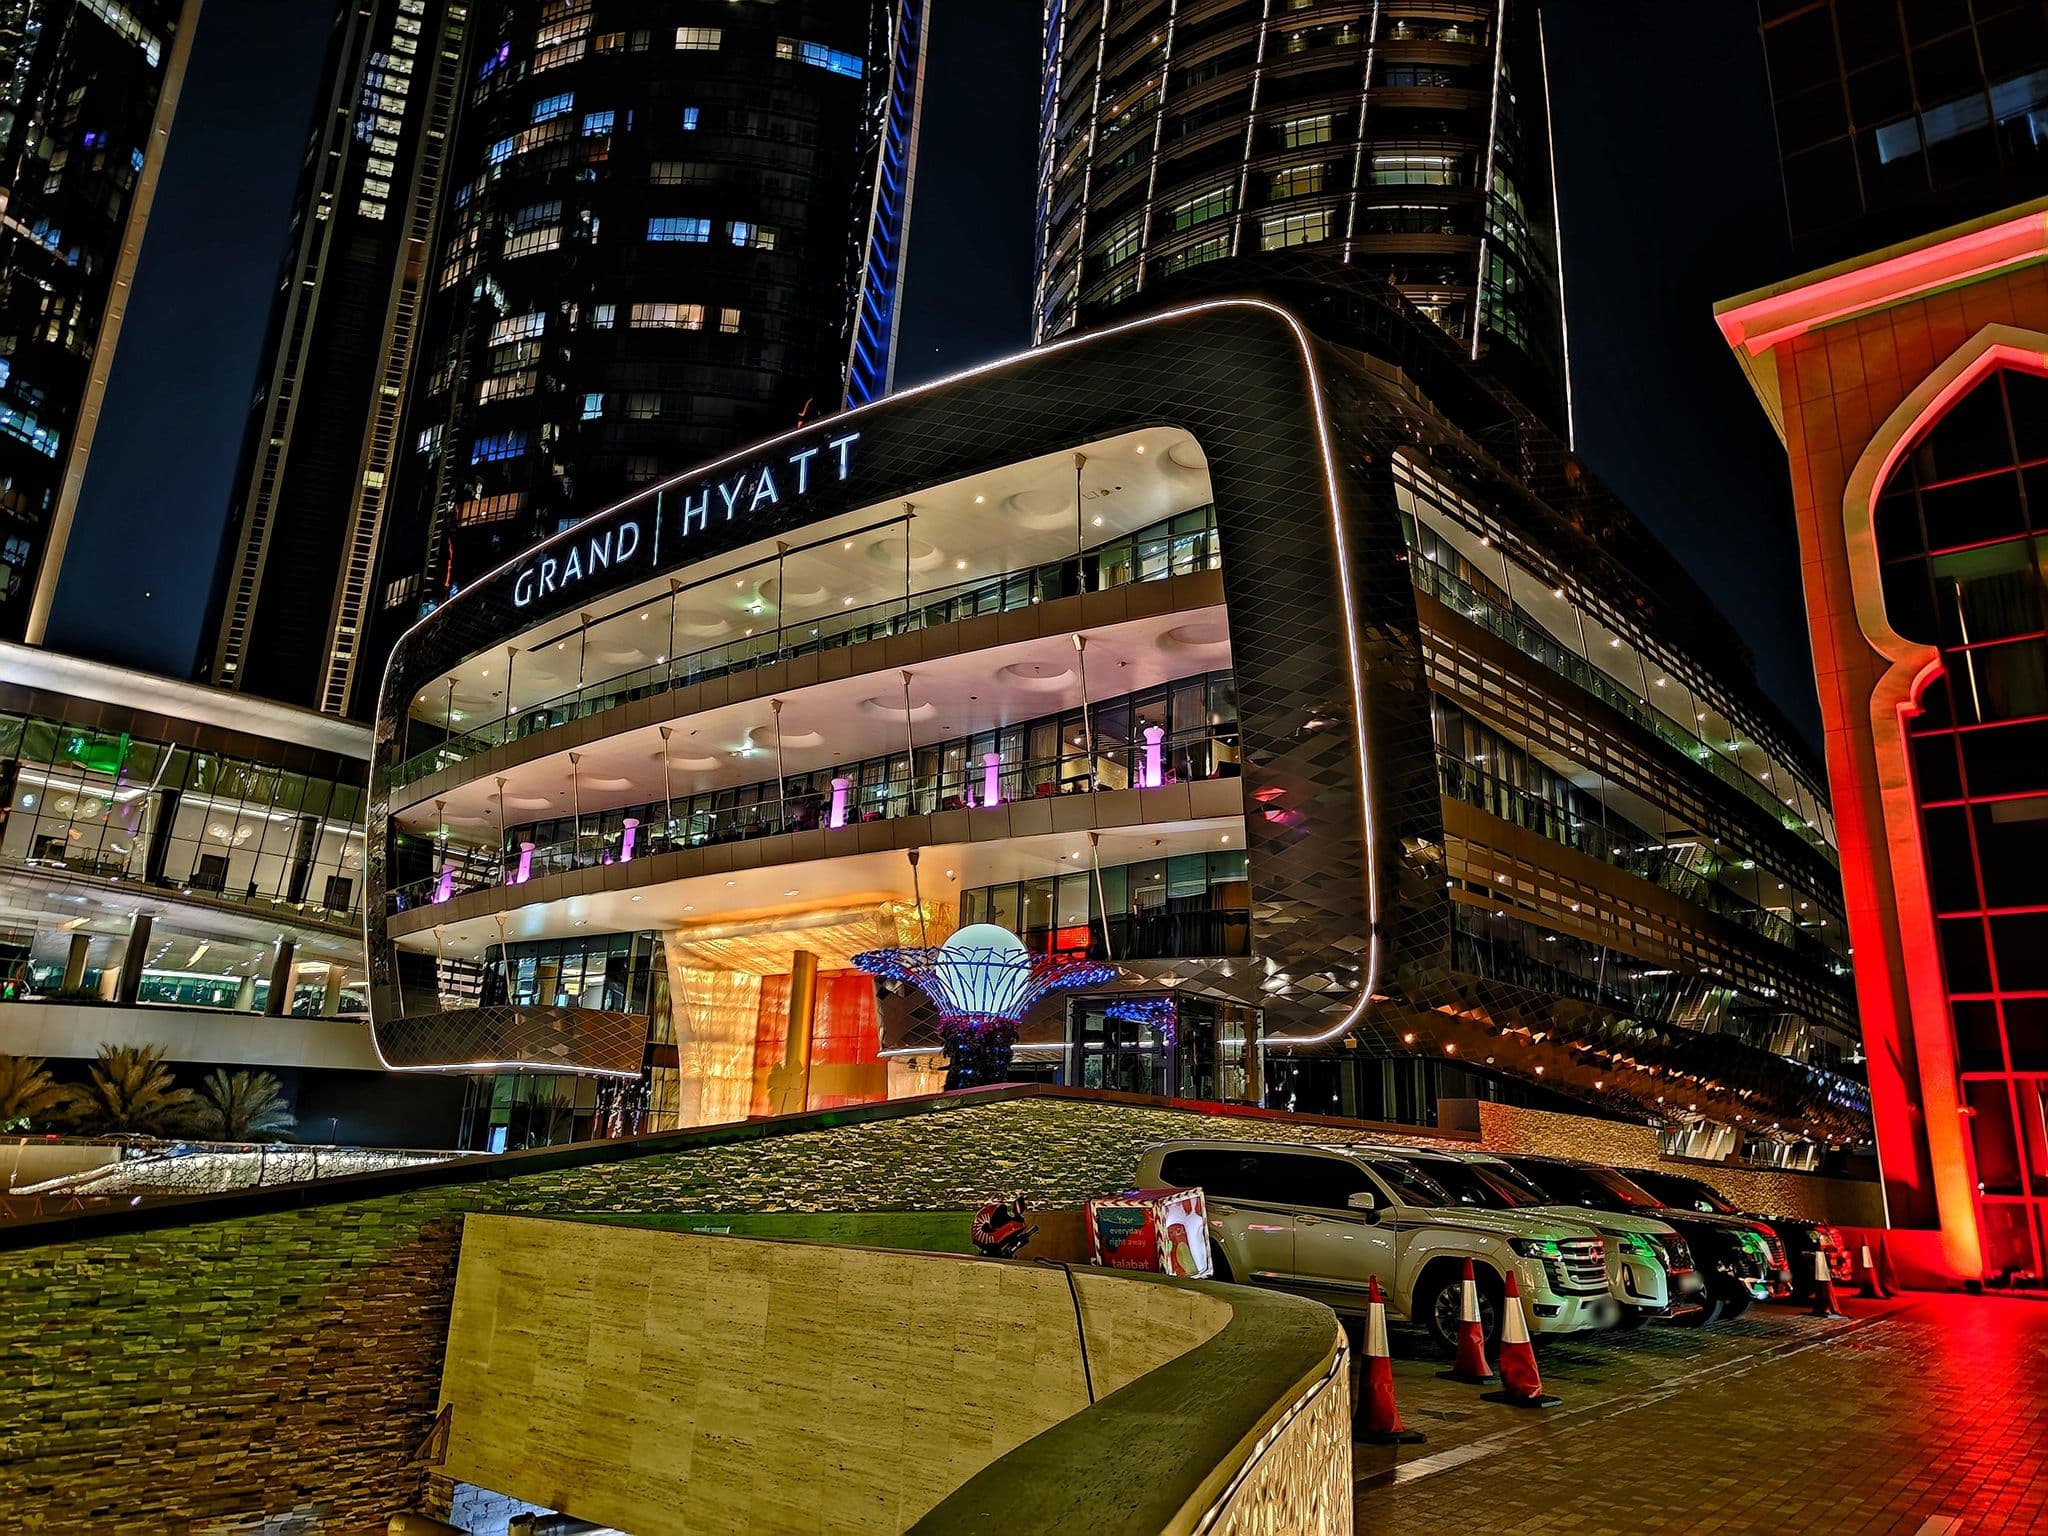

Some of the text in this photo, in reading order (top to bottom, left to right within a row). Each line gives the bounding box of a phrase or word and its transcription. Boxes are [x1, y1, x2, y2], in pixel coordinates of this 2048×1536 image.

[514, 432, 861, 608] GRAND HYATT
[1116, 1215, 1134, 1225] Your
[1109, 1237, 1146, 1249] right away
[1111, 1258, 1149, 1270] talabat
